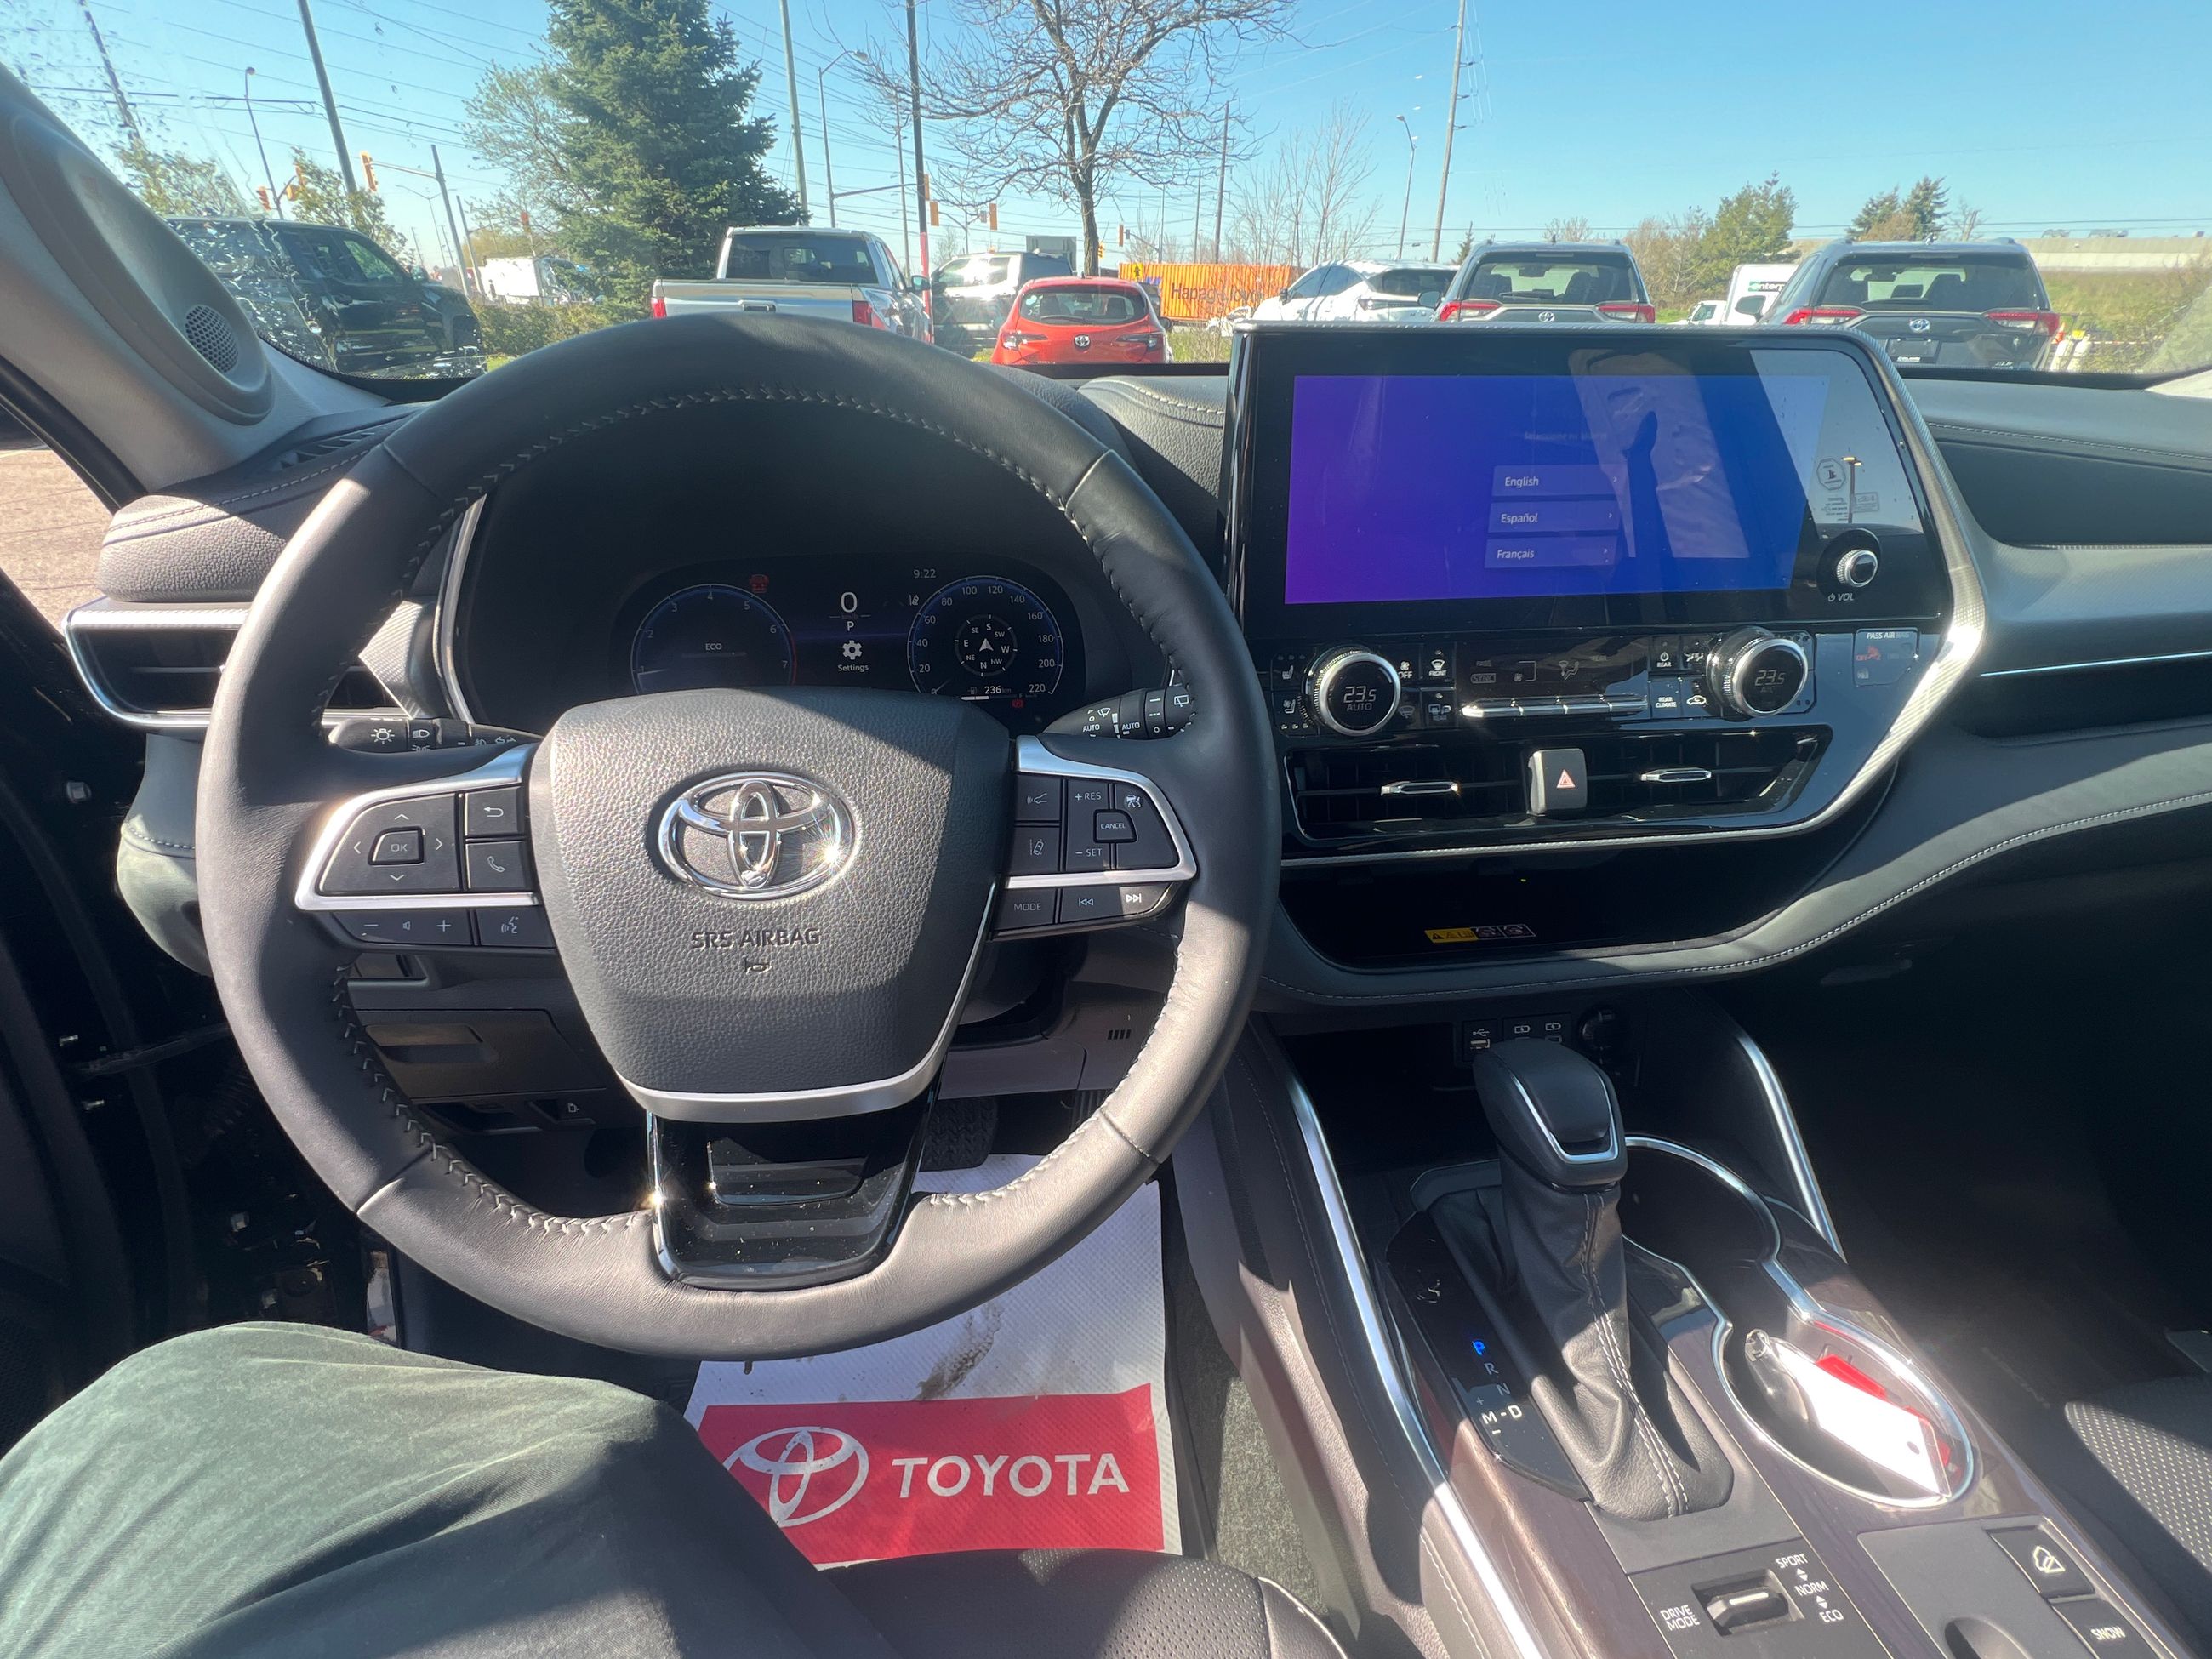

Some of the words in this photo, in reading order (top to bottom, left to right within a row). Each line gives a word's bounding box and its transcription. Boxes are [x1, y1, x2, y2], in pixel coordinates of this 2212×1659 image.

[1504, 476, 1539, 489] English
[1501, 512, 1538, 525] Español
[1497, 549, 1535, 561] Français
[913, 568, 937, 579] 9:22
[962, 586, 978, 595] 100
[988, 585, 1003, 595] 120
[941, 597, 953, 607] 80
[1010, 595, 1025, 604] 140
[1838, 593, 1855, 601] VOL
[671, 603, 678, 613] 3
[744, 601, 750, 610] 5
[924, 615, 936, 624] 60
[1027, 611, 1043, 620] 160
[769, 624, 777, 634] 6
[847, 620, 855, 631] P
[986, 623, 992, 631] S
[647, 630, 654, 638] 2
[1038, 634, 1054, 643] 180
[705, 642, 722, 651] ECO
[916, 638, 928, 647] 40
[963, 639, 969, 647] E
[782, 660, 788, 669] 7
[980, 661, 988, 670] N
[1038, 658, 1055, 668] 200
[837, 664, 869, 673] Settings
[919, 664, 931, 673] 20
[984, 686, 1001, 694] 236
[1029, 683, 1046, 693] 220
[1347, 703, 1373, 712] AUTO
[1082, 723, 1101, 733] AUTO
[1121, 721, 1141, 731] AUTO
[1100, 822, 1126, 830] CANCEL
[390, 842, 408, 852] OK
[1013, 903, 1042, 912] MODE
[690, 931, 736, 949] SRS
[738, 926, 822, 949] AIRBAG
[1472, 1338, 1486, 1356] P
[1483, 1362, 1499, 1376] R
[1496, 1382, 1511, 1396] N
[891, 1451, 1131, 1499] TOYOTA
[1775, 1553, 1809, 1569] SPORT
[1793, 1580, 1830, 1596] NORM
[1659, 1604, 1693, 1622] DRIVE
[1818, 1609, 1845, 1623] ECO
[1665, 1615, 1701, 1632] MODE
[2089, 1625, 2127, 1641] SNOW
